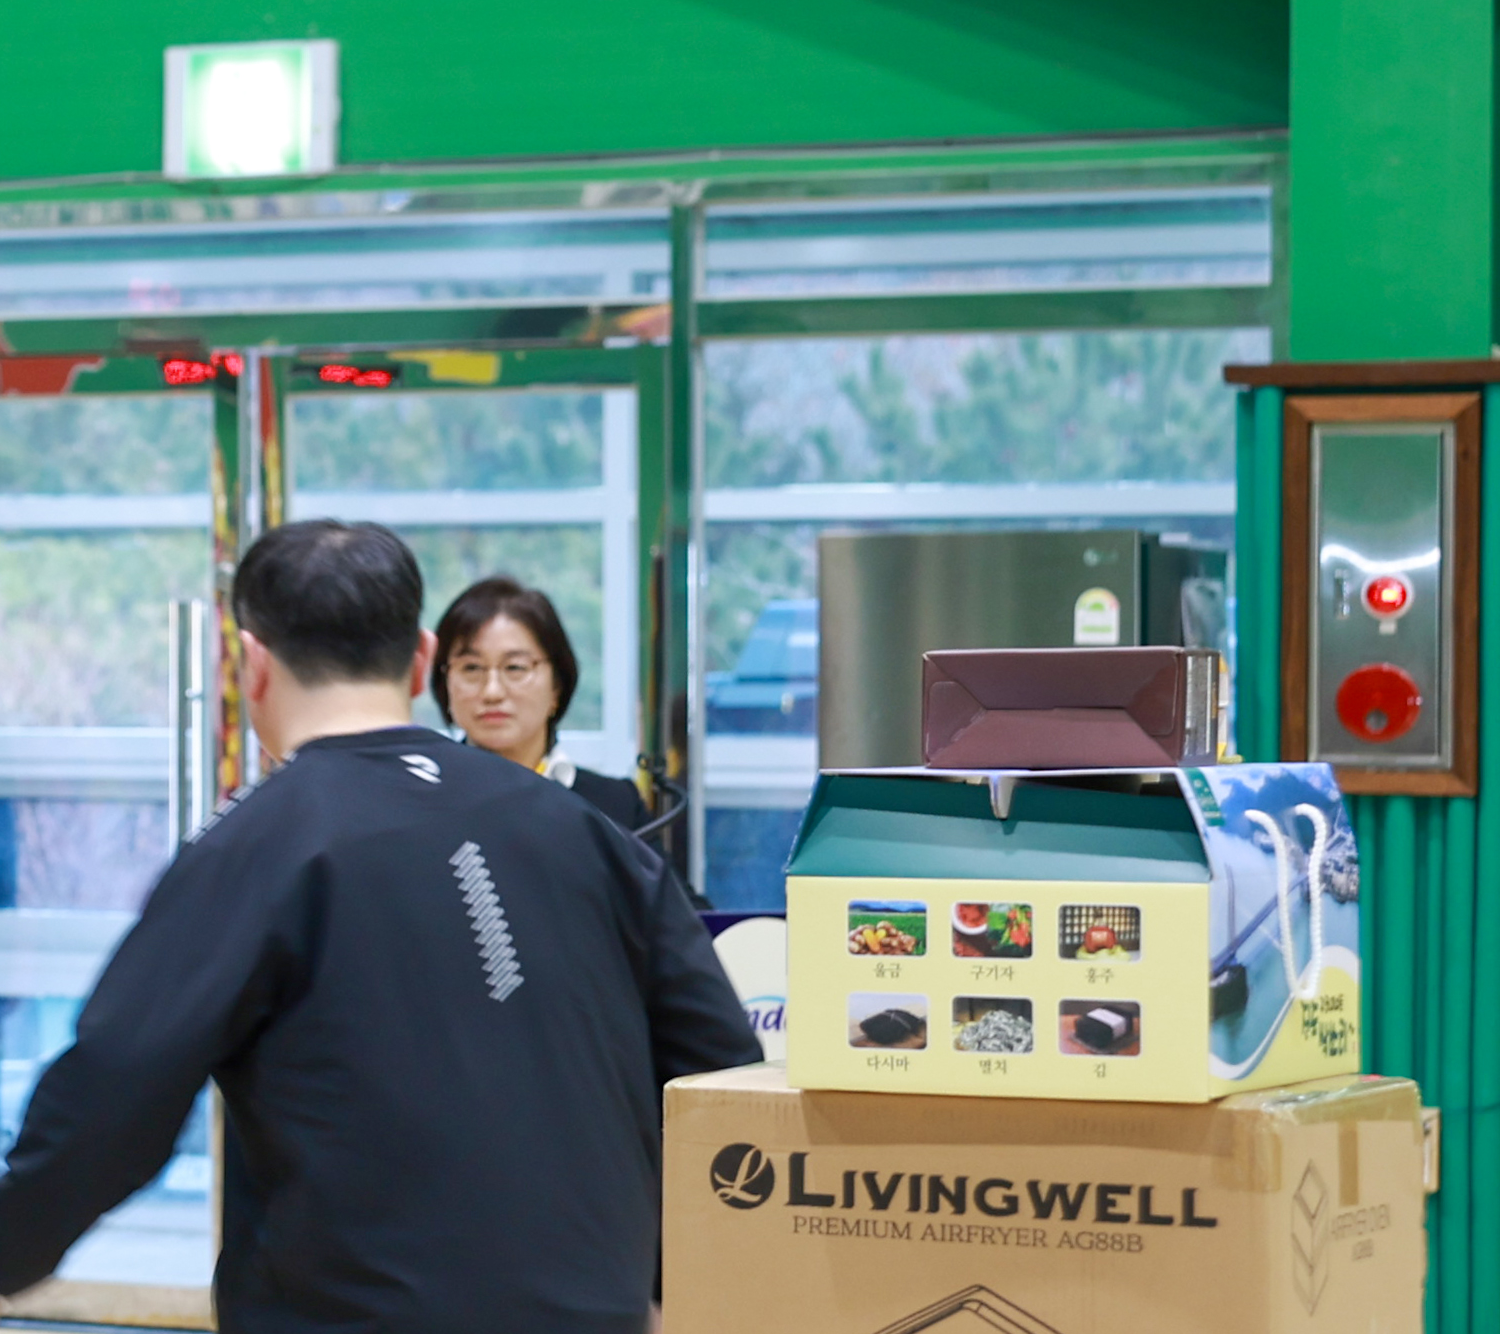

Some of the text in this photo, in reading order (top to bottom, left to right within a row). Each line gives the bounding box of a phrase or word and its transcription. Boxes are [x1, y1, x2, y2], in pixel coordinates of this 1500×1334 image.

[970, 964, 1015, 981] 구기자
[1084, 967, 1114, 985] 홍주
[866, 1055, 1107, 1079] 다시마 멸치 김
[784, 1151, 1218, 1228] LIVINGWELL
[793, 1215, 1144, 1253] PREMIUM AIRFRYER AG88B
